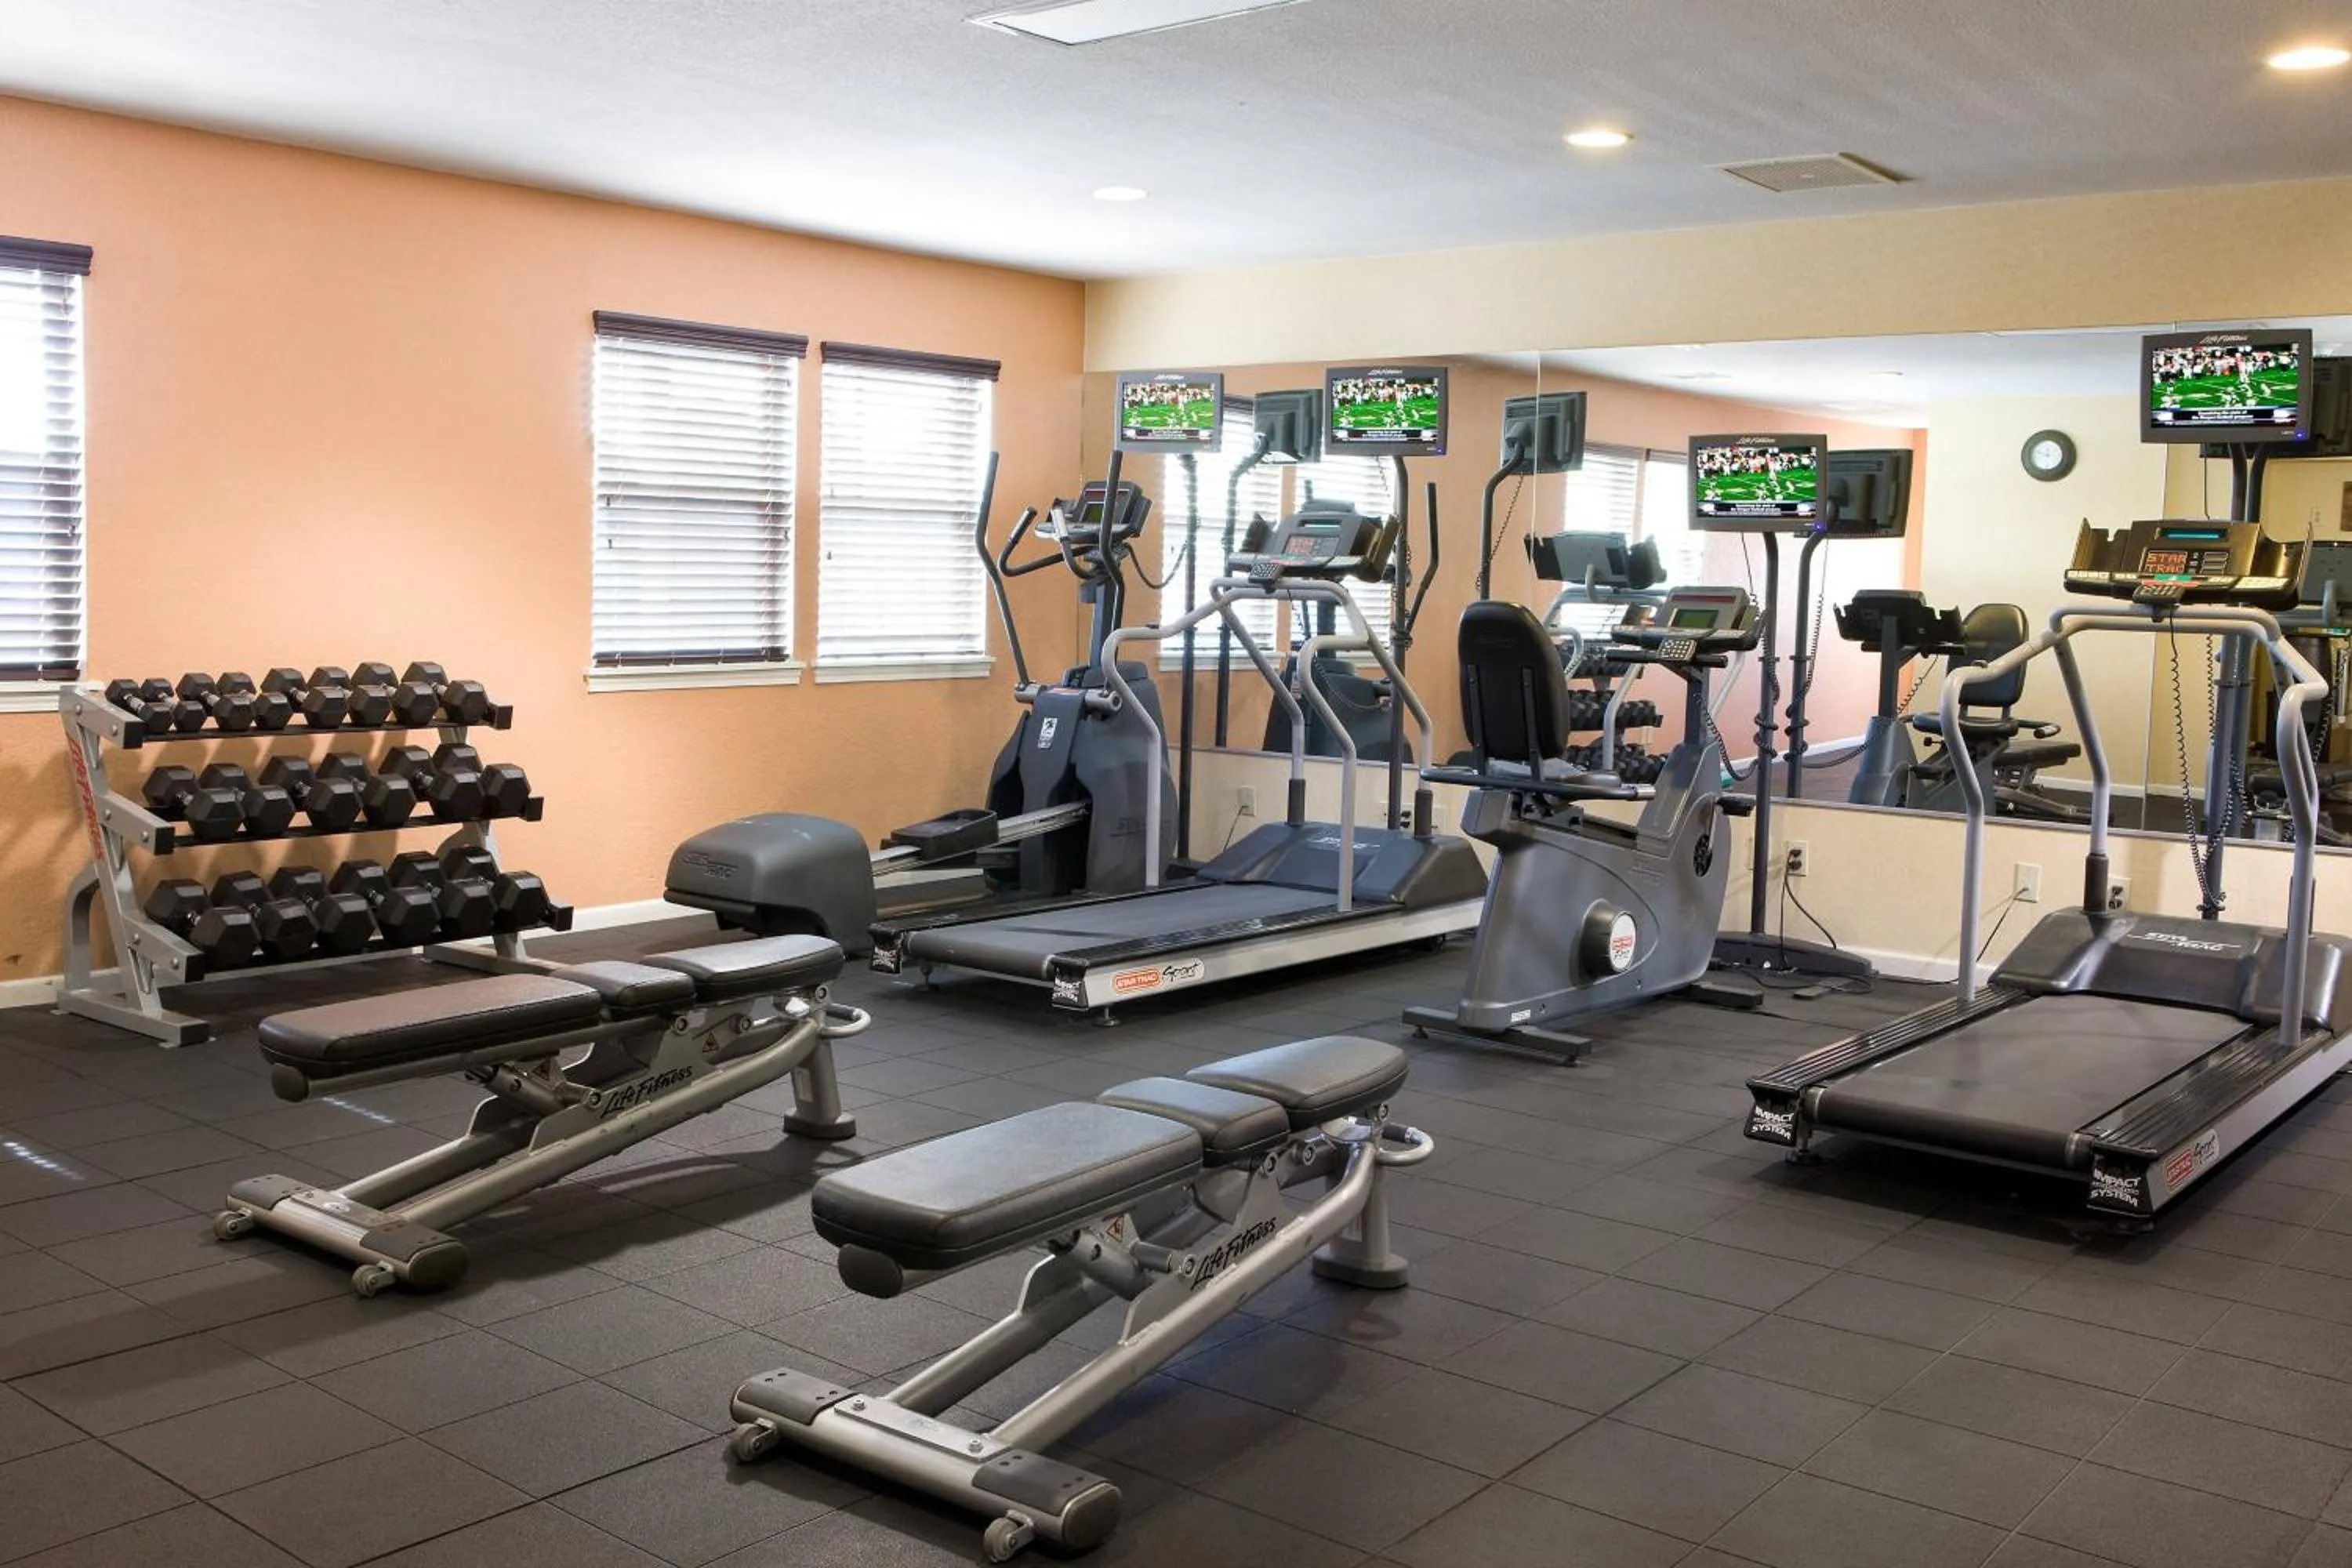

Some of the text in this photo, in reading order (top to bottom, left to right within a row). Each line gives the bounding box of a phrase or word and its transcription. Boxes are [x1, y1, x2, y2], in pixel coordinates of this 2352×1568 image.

[2147, 553, 2186, 564] STAR
[600, 1065, 693, 1119] Life Fitness
[1755, 1105, 1795, 1122] IMPACT
[1751, 1123, 1791, 1140] SYSTEM
[2093, 1168, 2141, 1187] IMPACT
[2090, 1189, 2138, 1207] SYSTEM
[1191, 1217, 1276, 1290] Life Fitness
